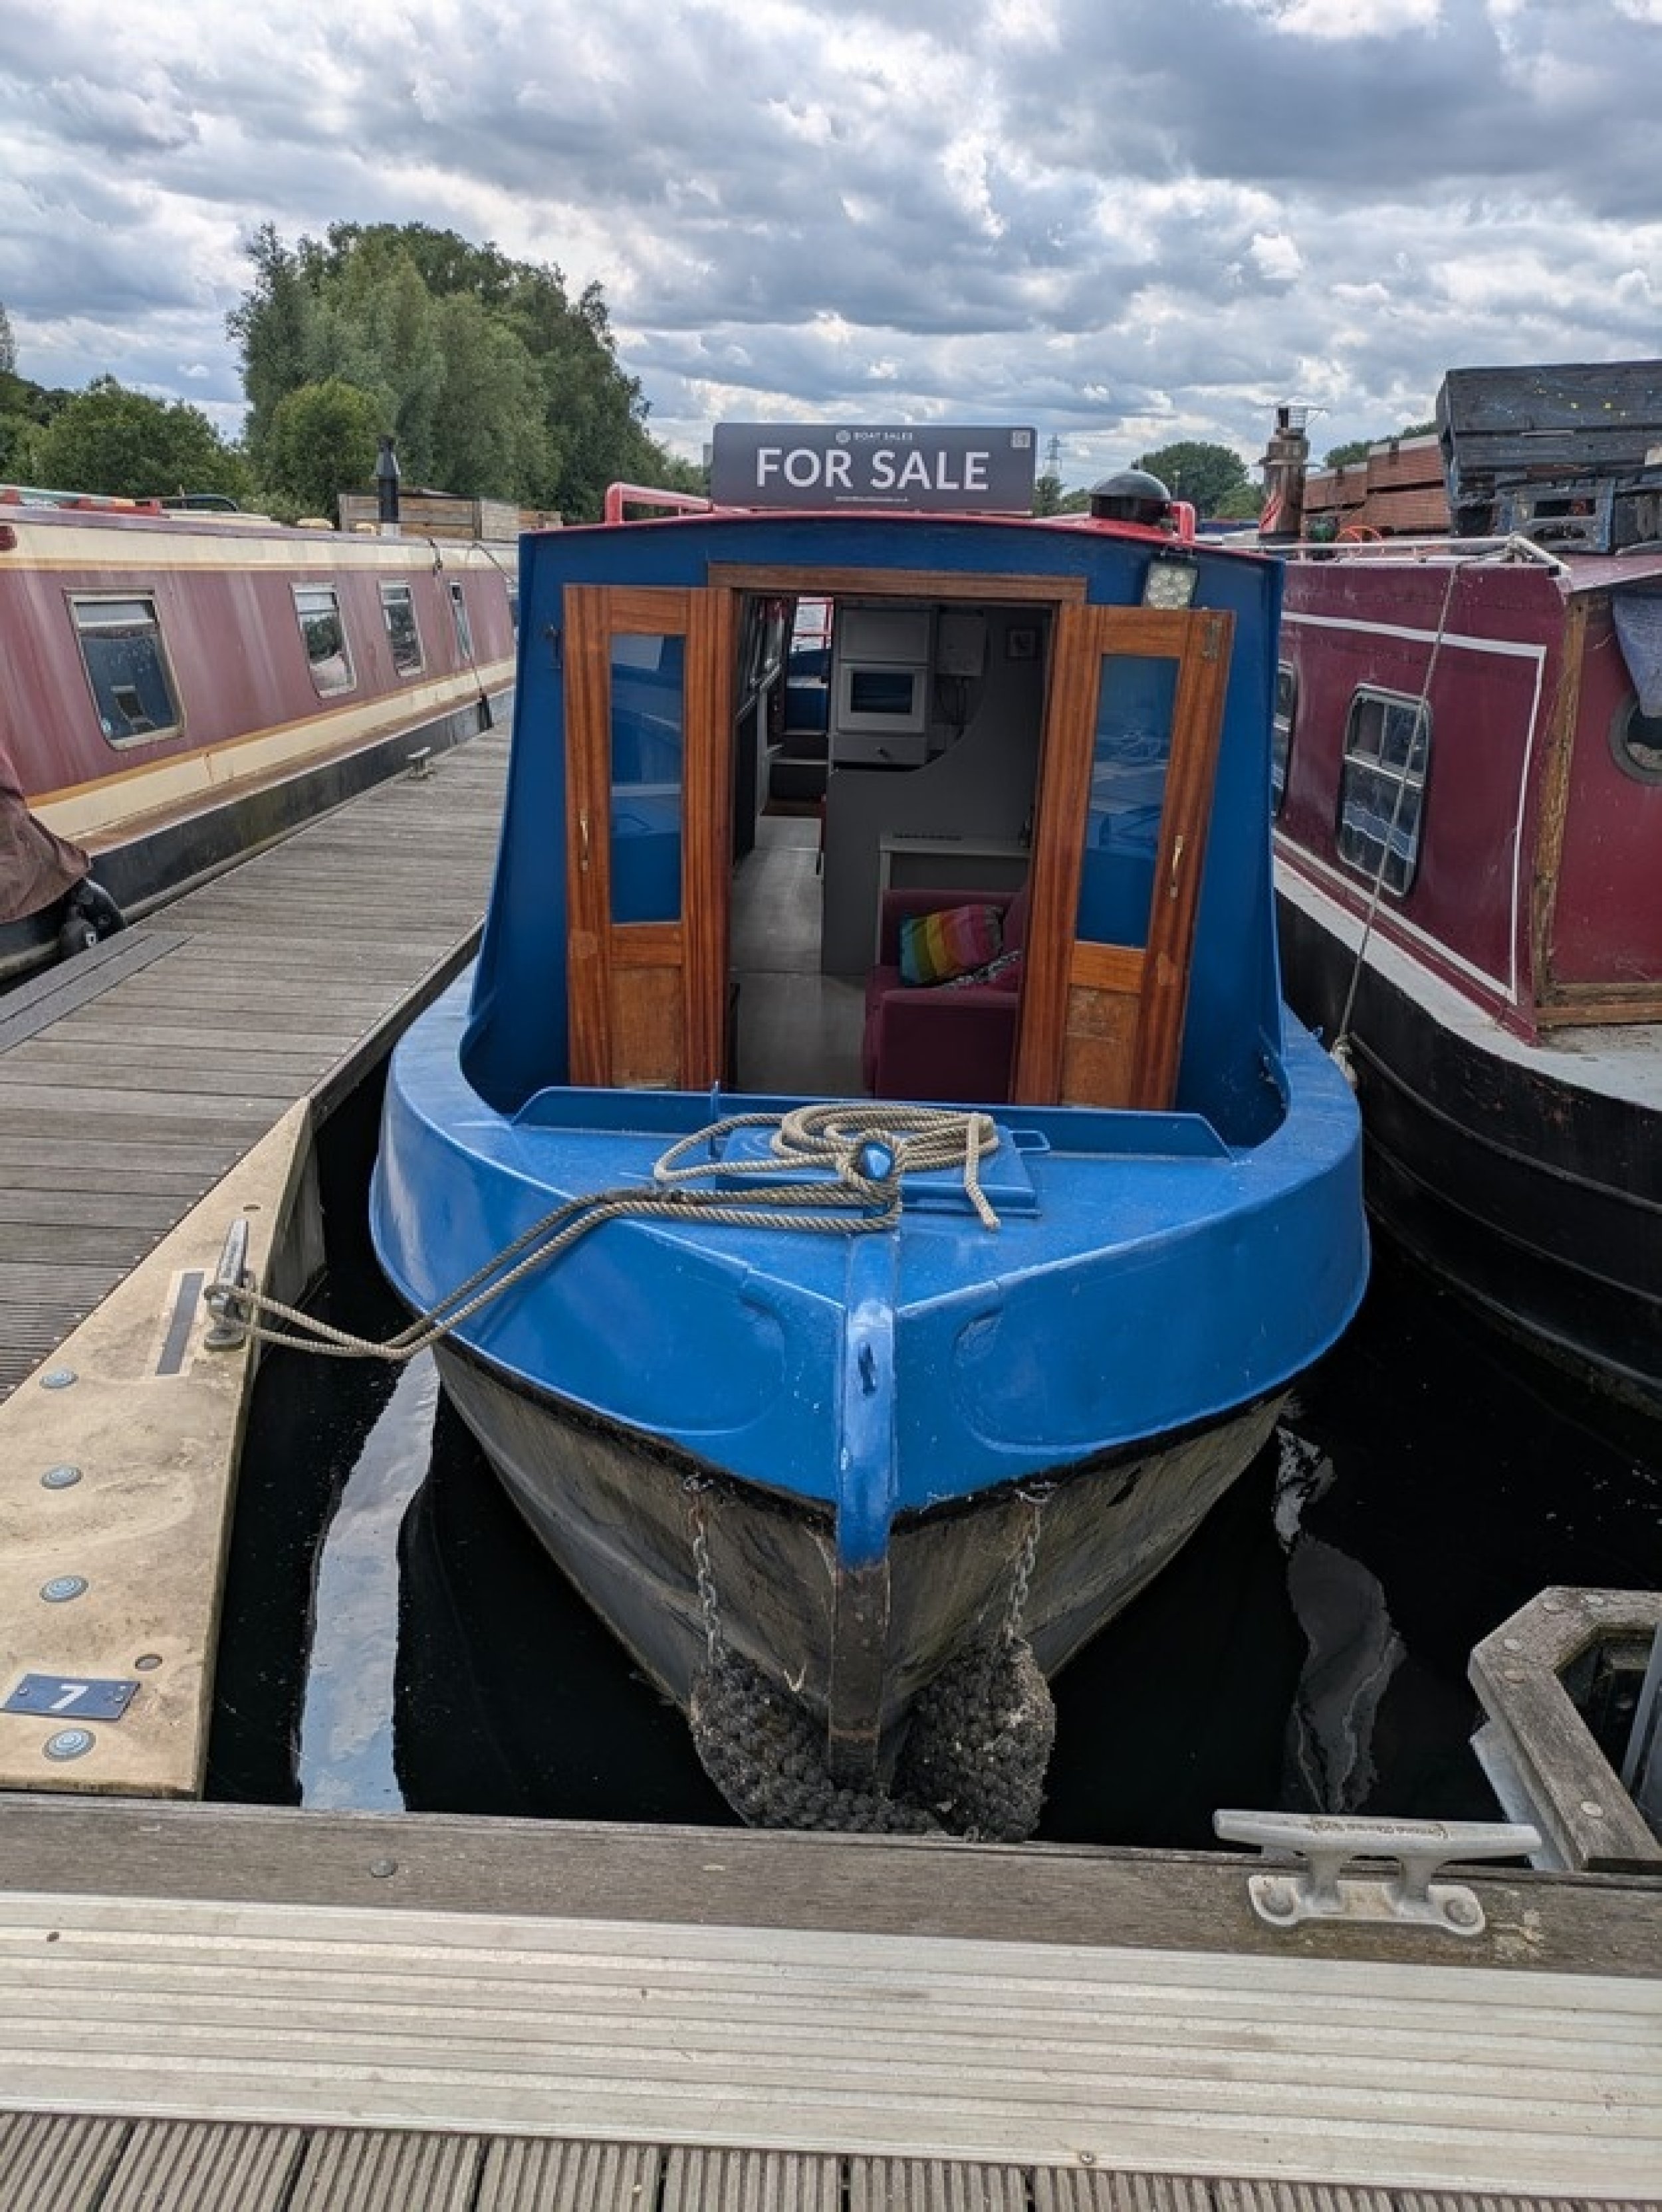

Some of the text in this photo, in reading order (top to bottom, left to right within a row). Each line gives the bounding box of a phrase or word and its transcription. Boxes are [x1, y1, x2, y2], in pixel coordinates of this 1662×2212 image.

[757, 447, 990, 490] FOR SALE
[49, 1683, 89, 1709] 7
